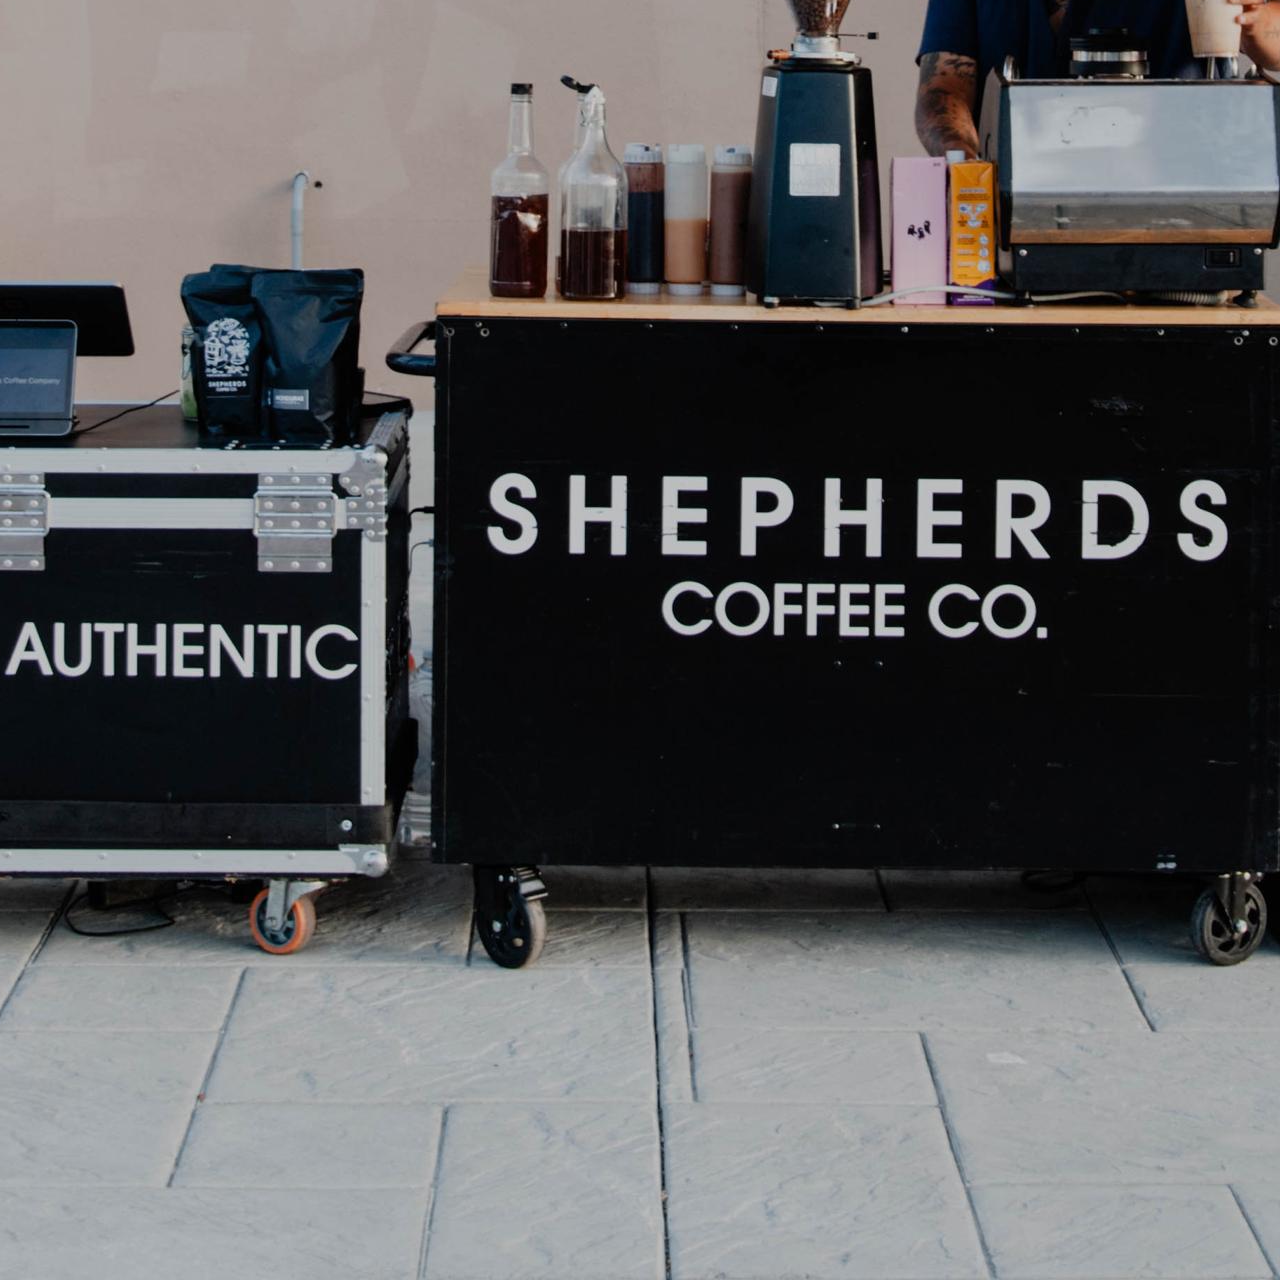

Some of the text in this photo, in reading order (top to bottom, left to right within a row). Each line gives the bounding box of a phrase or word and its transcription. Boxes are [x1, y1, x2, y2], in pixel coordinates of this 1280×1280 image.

[486, 471, 1229, 563] SHEPHERDS
[660, 579, 1048, 639] COFFEE CO.
[4, 620, 359, 680] AUTHENTIC
